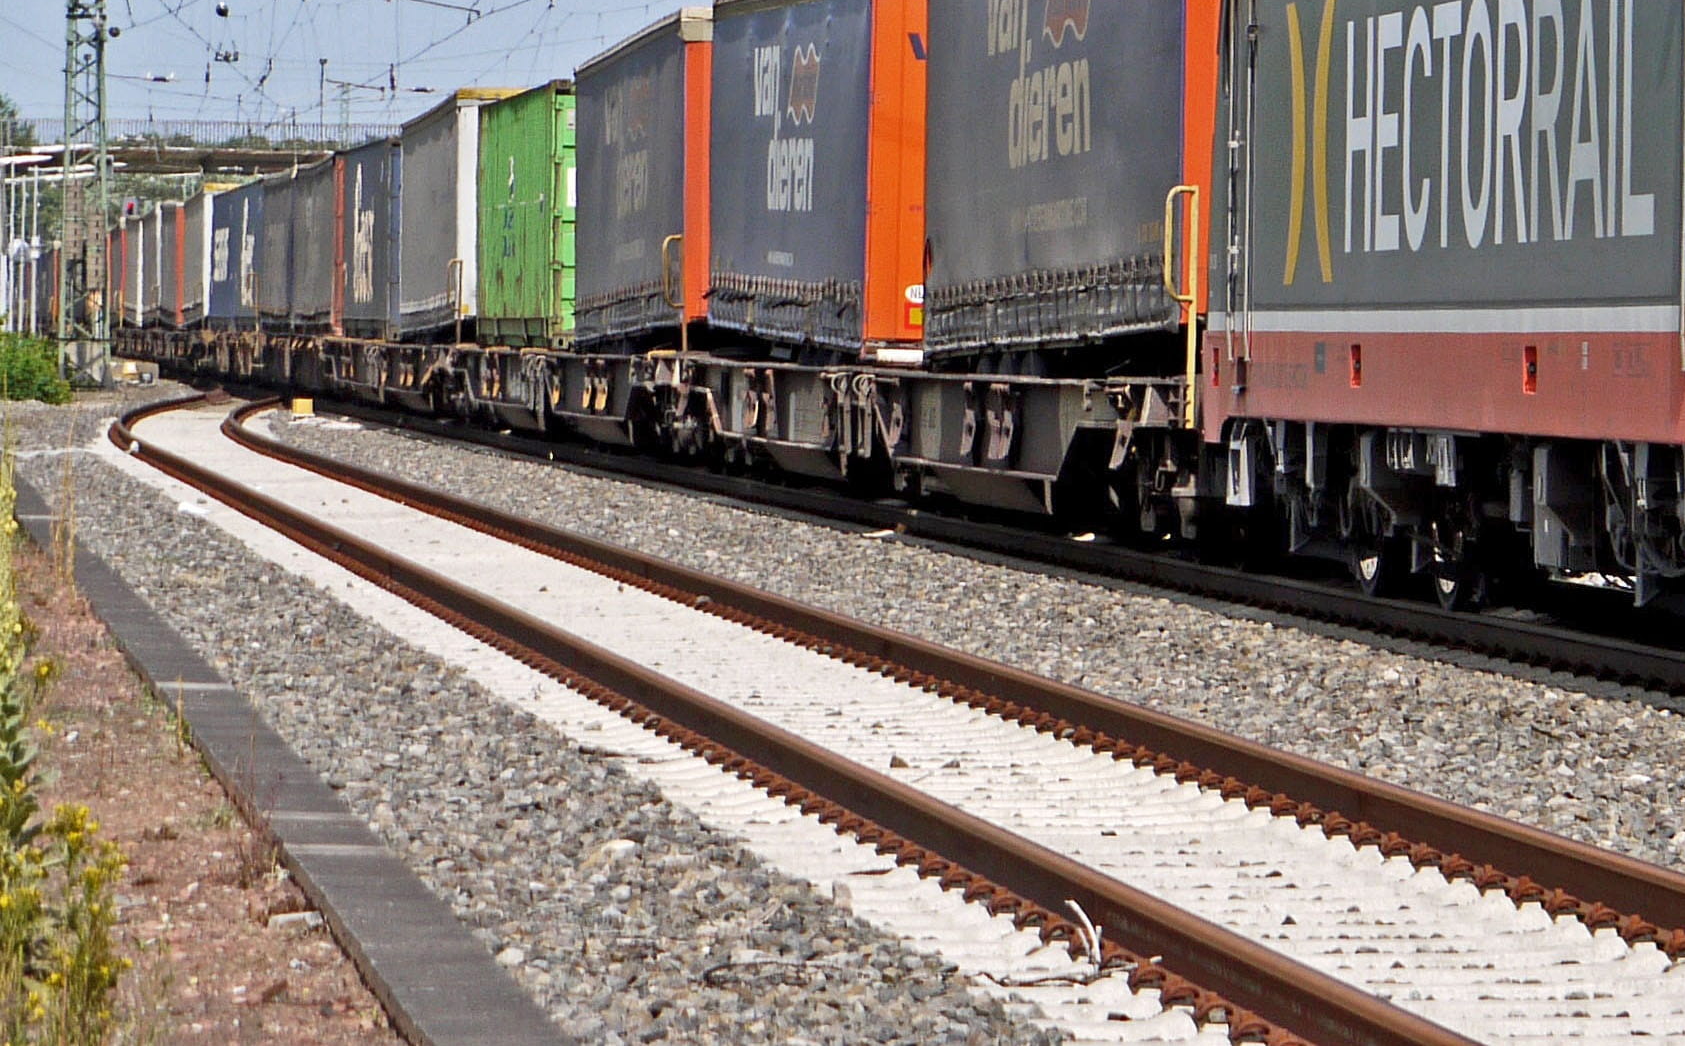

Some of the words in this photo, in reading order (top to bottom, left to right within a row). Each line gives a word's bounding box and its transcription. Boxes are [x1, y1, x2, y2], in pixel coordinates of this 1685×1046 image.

[754, 46, 780, 116] van
[1008, 38, 1092, 170] dieren
[767, 112, 815, 211] dieren
